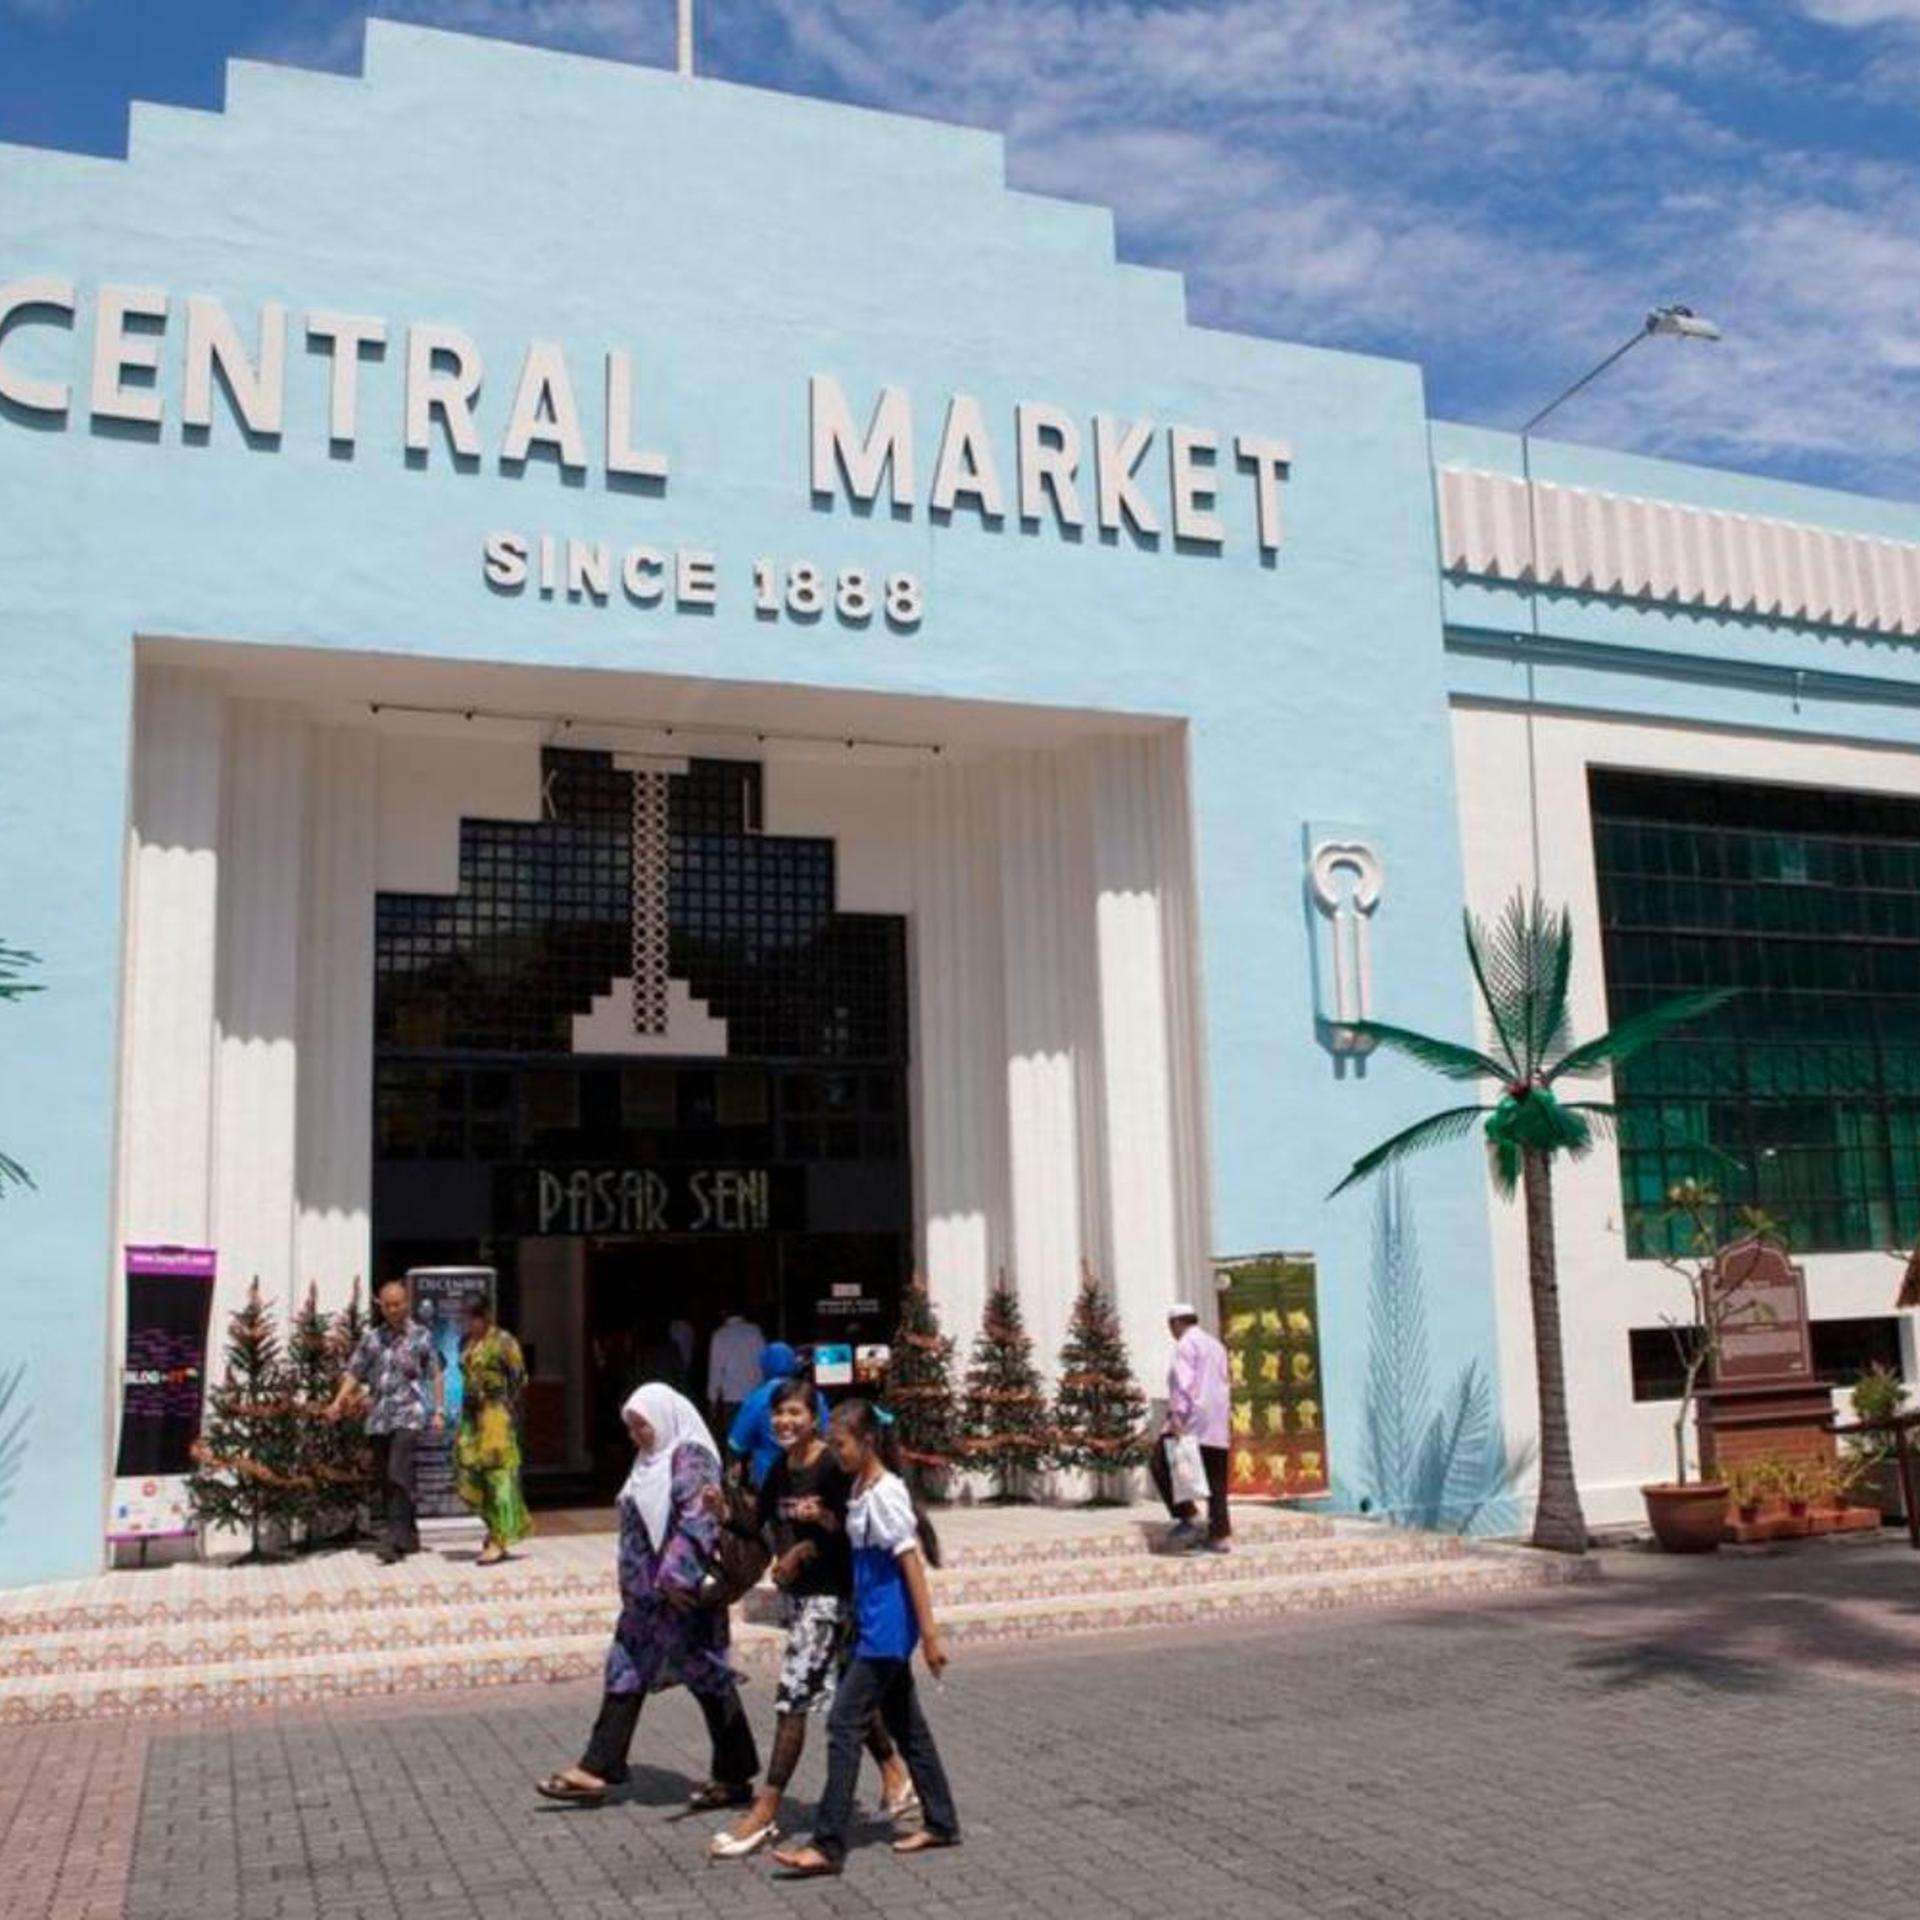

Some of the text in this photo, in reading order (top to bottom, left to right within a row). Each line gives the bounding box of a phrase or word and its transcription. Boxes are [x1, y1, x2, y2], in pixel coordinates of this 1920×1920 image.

[0, 277, 1292, 556] CENTRAL MARKET
[484, 529, 924, 628] SINCE 1888
[537, 1168, 770, 1233] PASAR SENI
